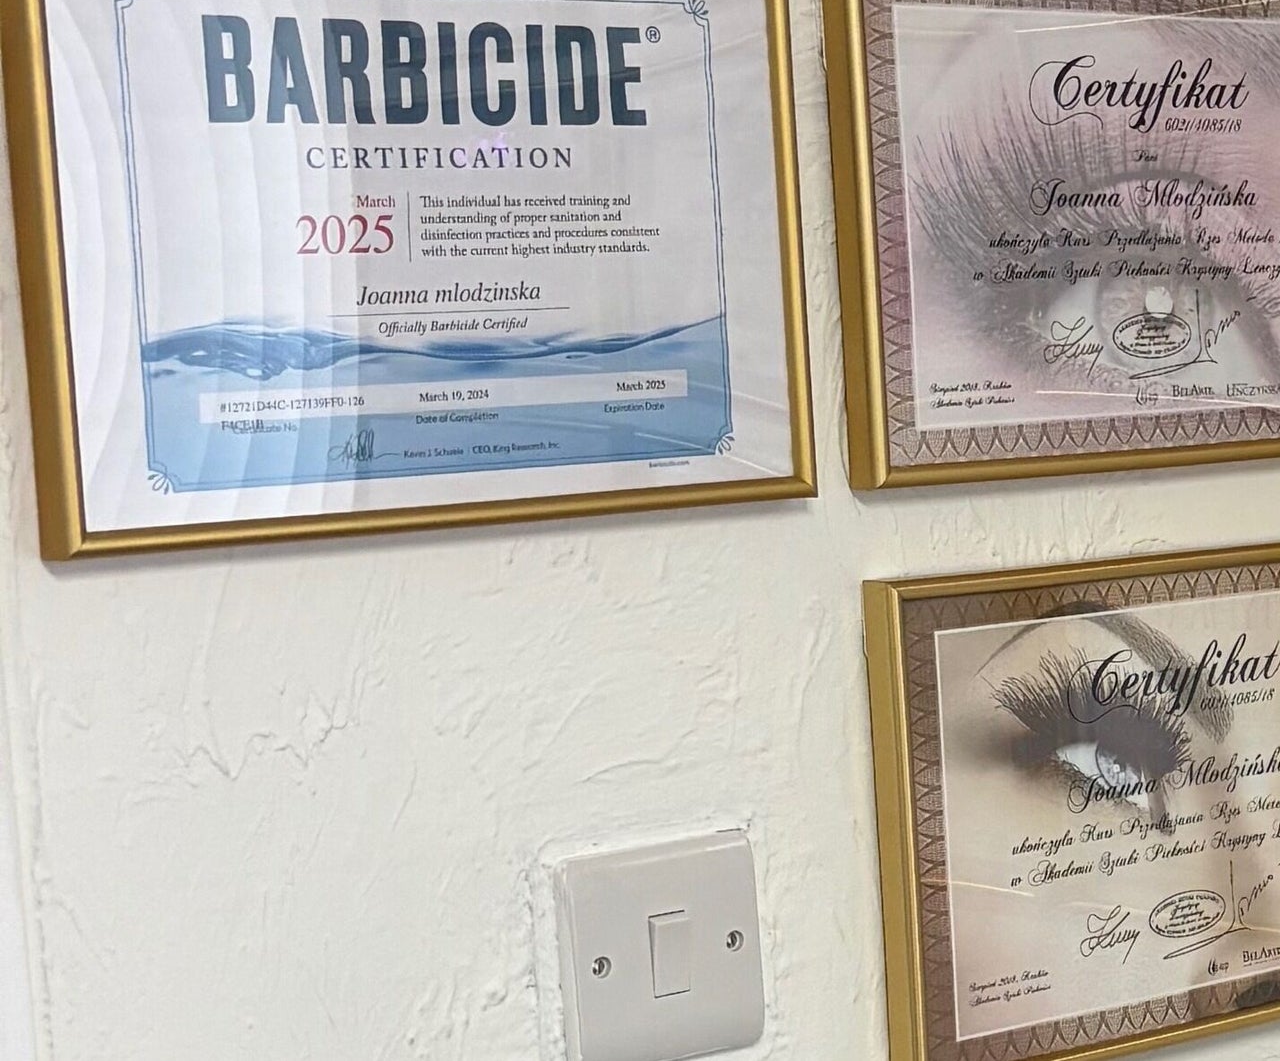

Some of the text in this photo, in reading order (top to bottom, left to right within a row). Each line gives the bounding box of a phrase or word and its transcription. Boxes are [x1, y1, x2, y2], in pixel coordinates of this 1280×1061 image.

[1029, 55, 1249, 133] Certyfikat
[306, 146, 573, 169] CERTIFICATION
[356, 195, 396, 208] March
[420, 194, 631, 209] This individual has received training and
[1029, 178, 1124, 216] Joanna
[297, 214, 394, 255] 2025
[357, 282, 541, 309] Joanna mlodzinska
[1067, 633, 1280, 723] Certyfikat
[1067, 777, 1157, 812] Joanna
